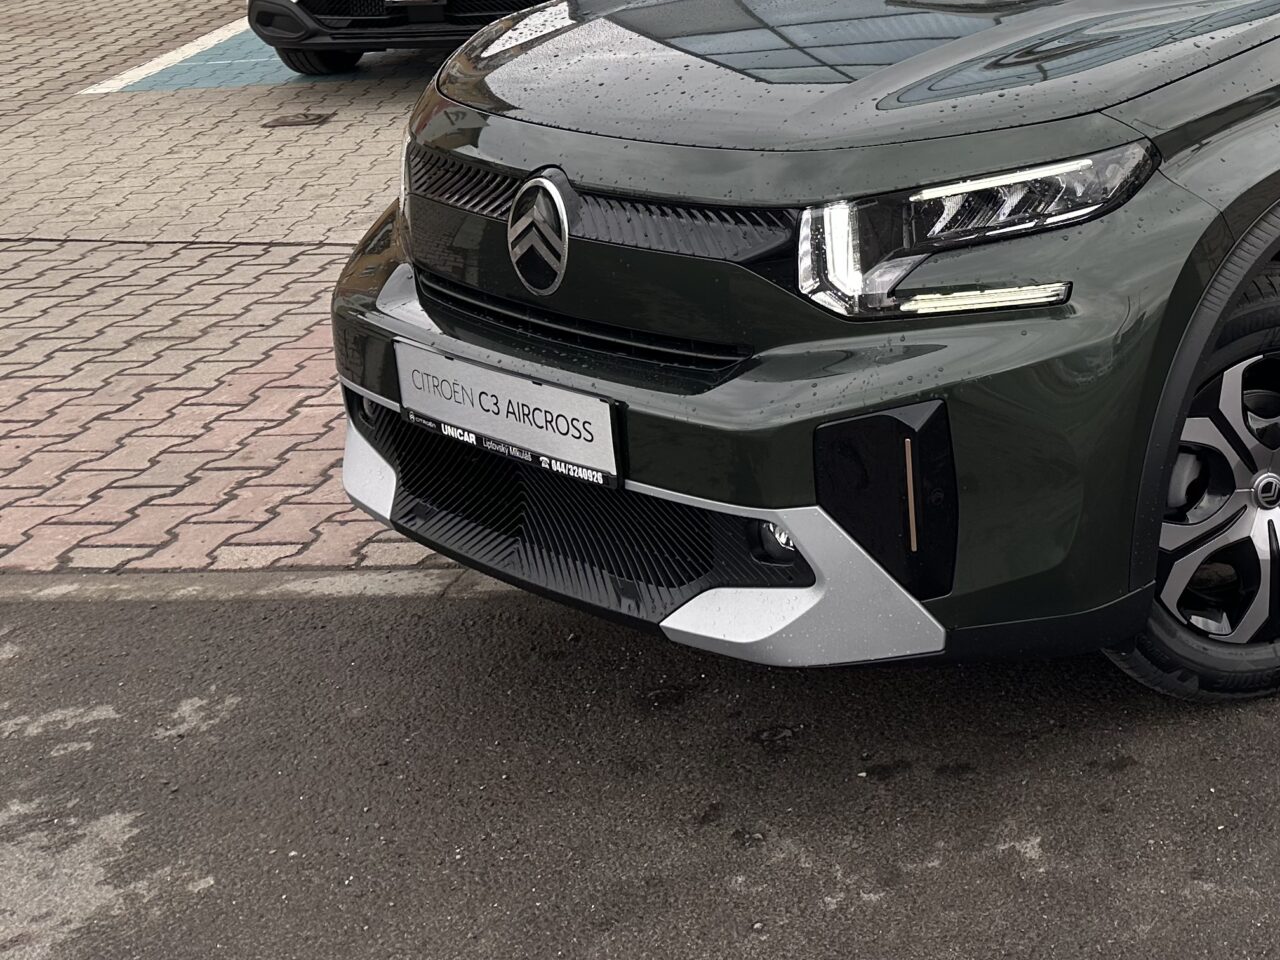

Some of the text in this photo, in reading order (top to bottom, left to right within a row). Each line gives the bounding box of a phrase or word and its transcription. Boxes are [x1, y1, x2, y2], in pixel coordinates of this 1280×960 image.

[411, 368, 594, 443] CITROËN C3 AIRCROSS
[441, 423, 477, 446] UNICAR
